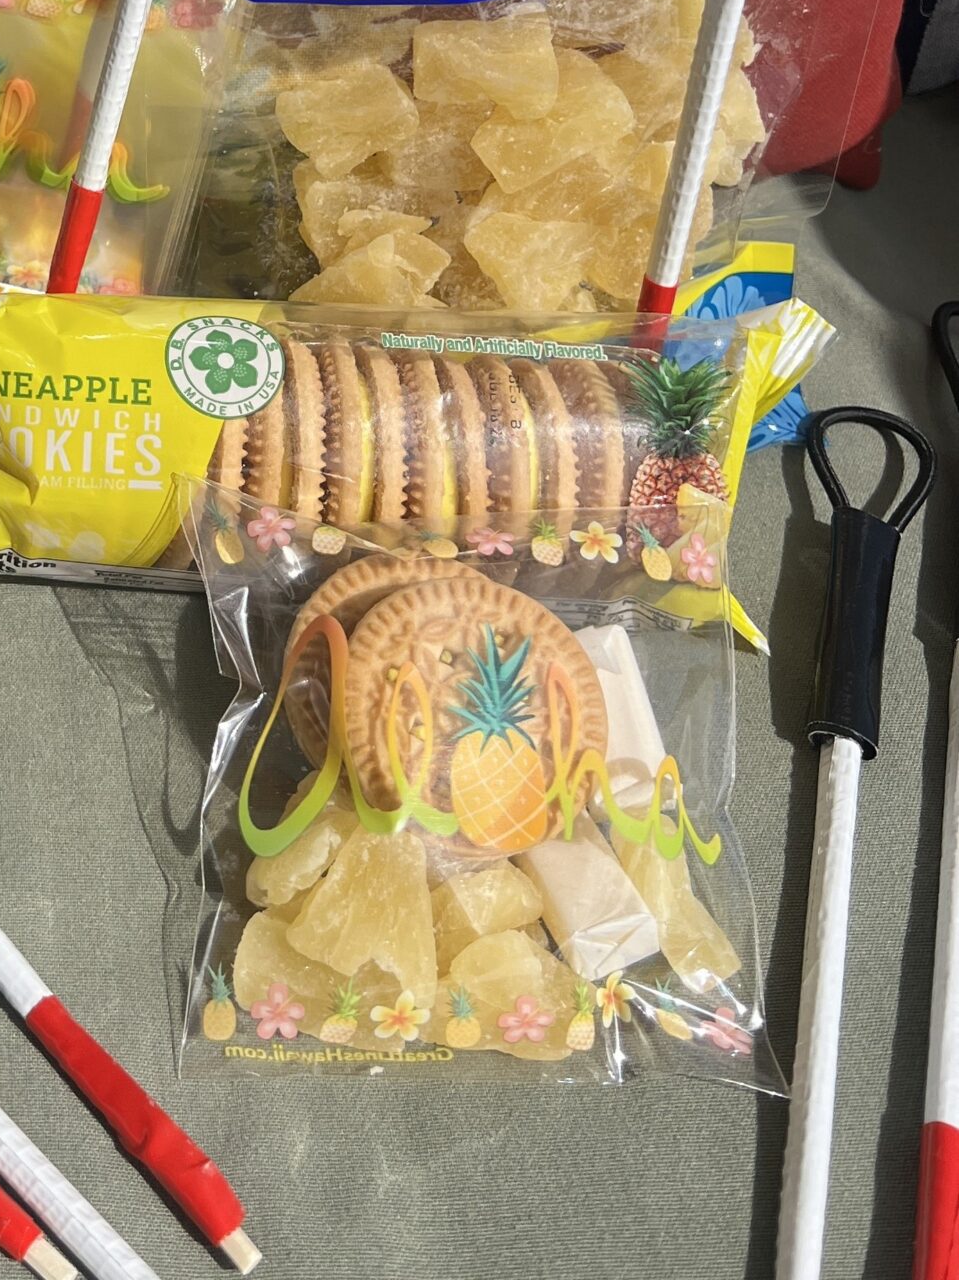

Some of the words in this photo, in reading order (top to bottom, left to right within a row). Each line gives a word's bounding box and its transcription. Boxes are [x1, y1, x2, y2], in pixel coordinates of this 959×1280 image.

[187, 318, 279, 352] SNACKS
[381, 333, 444, 353] Naturally
[446, 337, 473, 352] and
[474, 335, 542, 359] Artificially
[544, 342, 608, 360] Flavored.
[184, 387, 227, 416] MADE
[238, 401, 255, 414] IN
[259, 370, 280, 400] USA
[9, 426, 162, 477] OKIES
[67, 476, 126, 490] FILLING
